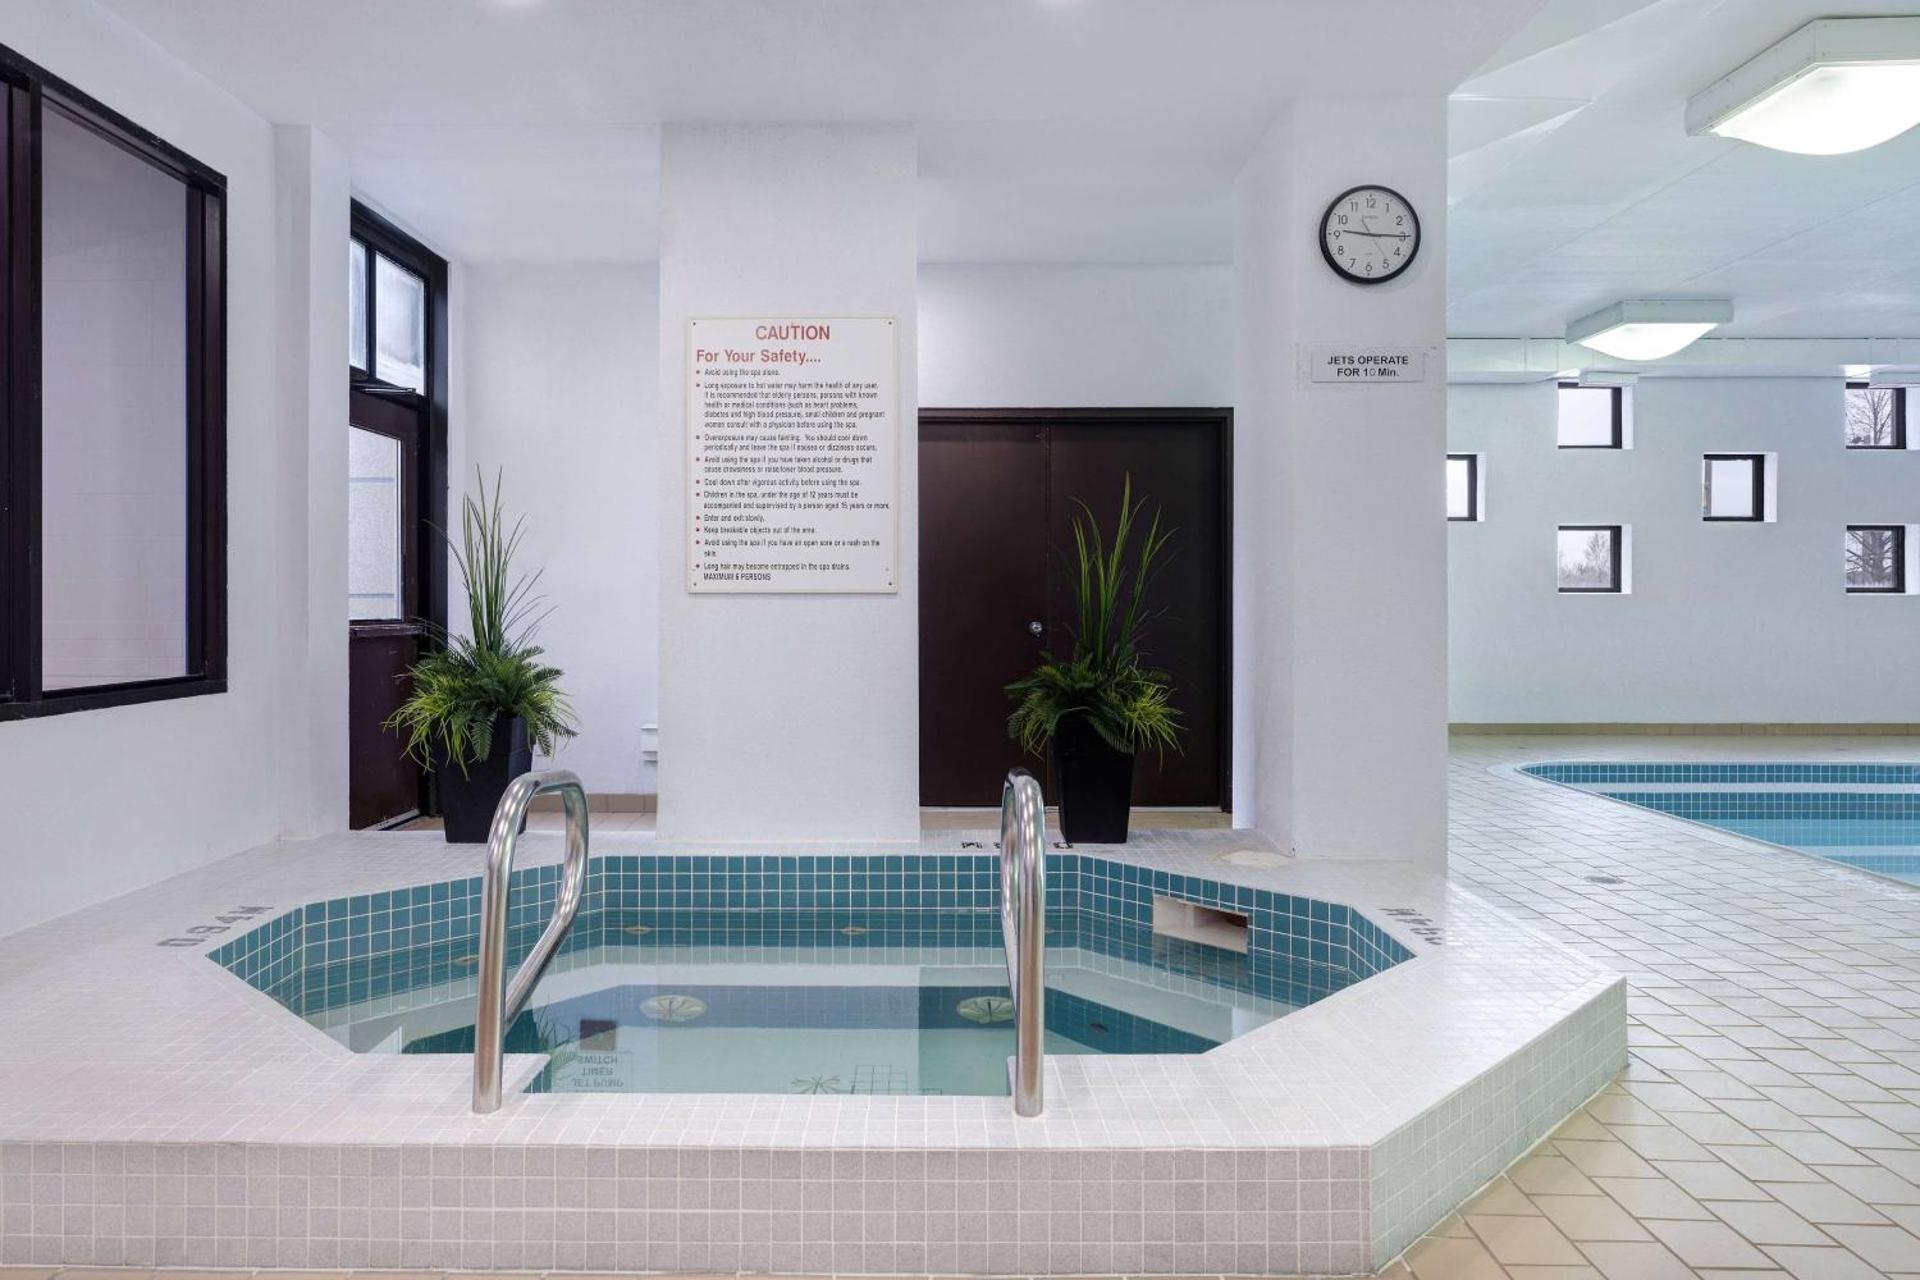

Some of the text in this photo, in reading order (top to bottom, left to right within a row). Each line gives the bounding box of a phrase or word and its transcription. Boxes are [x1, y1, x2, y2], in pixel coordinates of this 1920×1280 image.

[1350, 201, 1358, 212] 11
[1366, 198, 1376, 208] 12
[1385, 203, 1390, 213] 1
[1338, 215, 1348, 225] 10
[1395, 215, 1403, 226] 2
[1333, 230, 1341, 240] 9
[1399, 231, 1406, 242] 3
[1337, 245, 1344, 255] 8
[1393, 246, 1400, 256] 4
[1349, 258, 1356, 268] 7
[1365, 262, 1372, 272] 6
[1382, 259, 1390, 269] 5
[755, 325, 830, 340] CAUTION
[696, 350, 822, 366] For Your Safety....
[1327, 355, 1409, 365] JETS OPERATE
[1337, 368, 1360, 377] FOR
[1378, 368, 1400, 377] Min.
